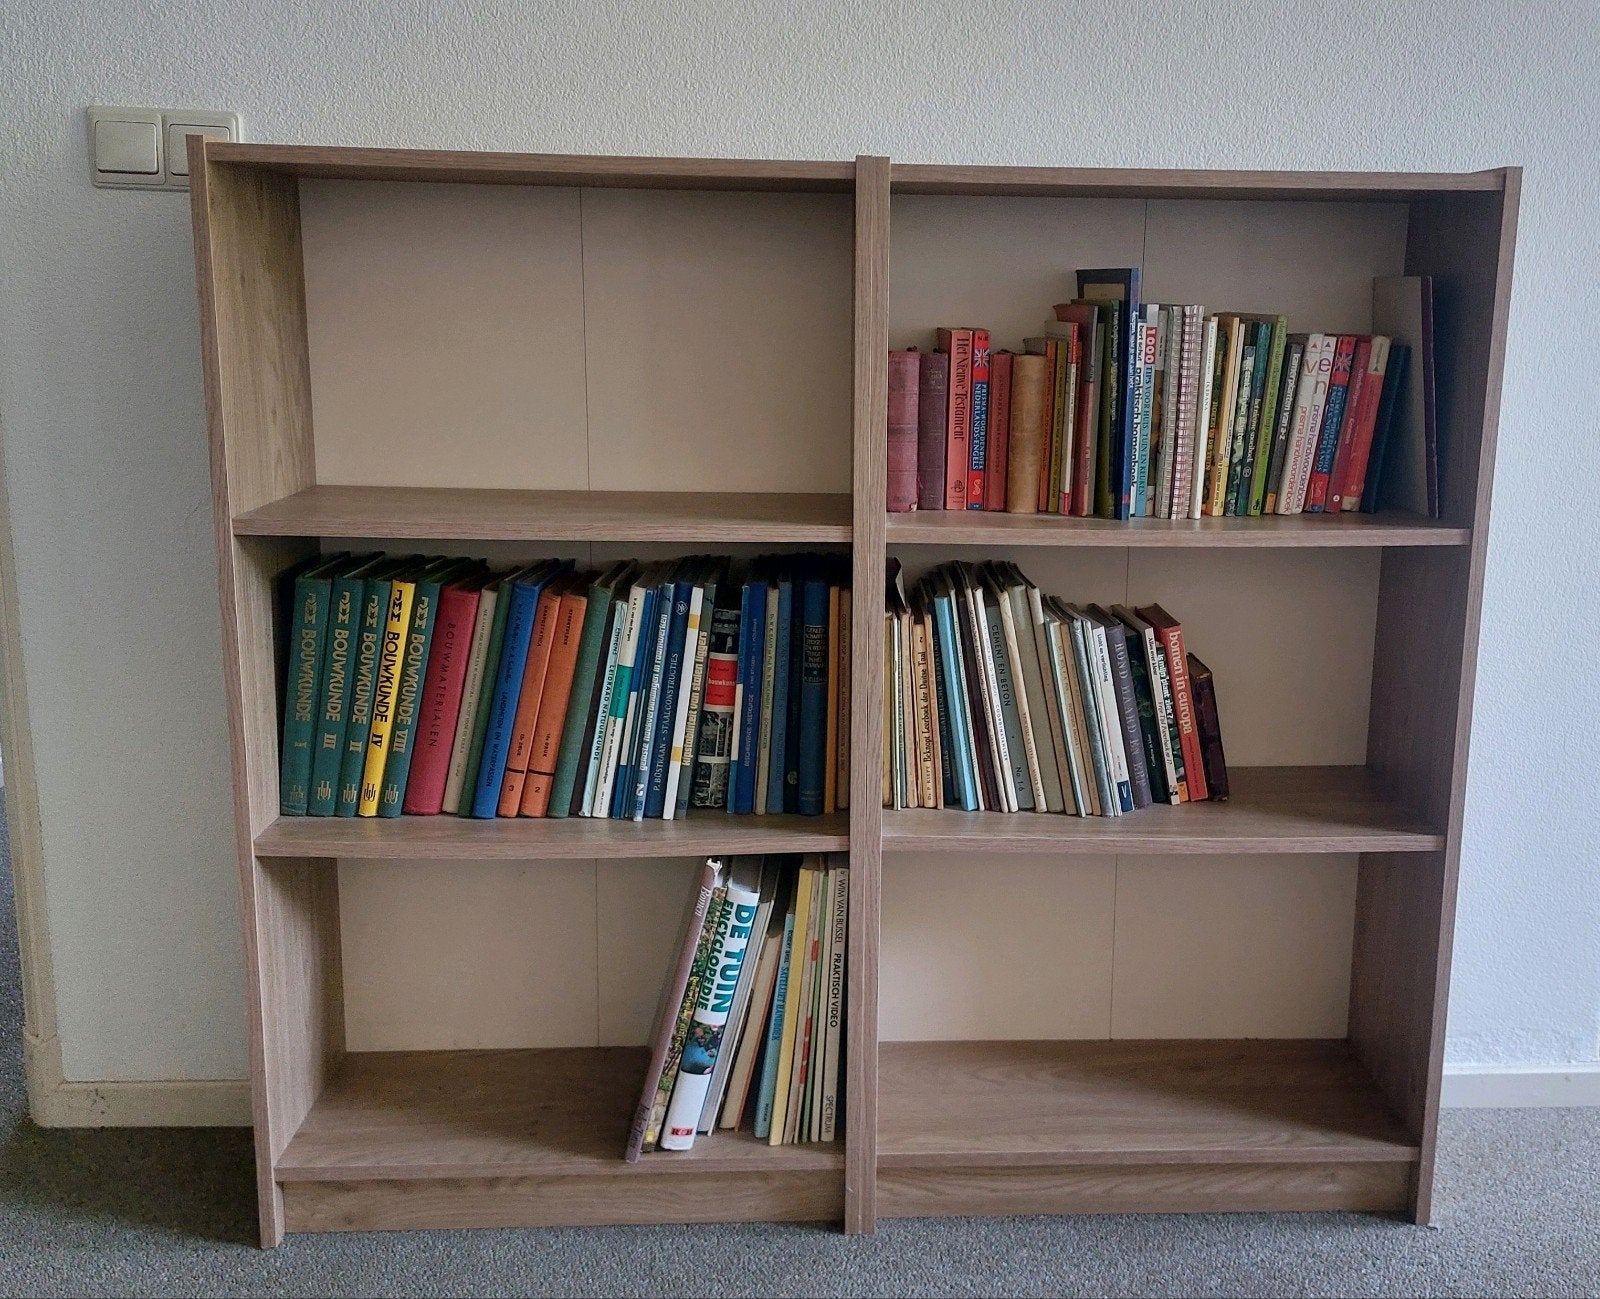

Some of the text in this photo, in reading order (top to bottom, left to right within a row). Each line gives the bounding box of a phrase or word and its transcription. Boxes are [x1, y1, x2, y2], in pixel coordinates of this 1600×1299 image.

[956, 337, 969, 355] Het
[1136, 340, 1144, 361] schut
[1144, 327, 1156, 364] 1000
[1143, 385, 1151, 409] VOOR
[1144, 365, 1153, 385] TIPS
[1282, 352, 1301, 411] kamerplanten
[953, 390, 967, 442] Testament
[970, 383, 982, 470] NEDERLANDS-ENGELS
[1280, 410, 1290, 427] van
[1139, 453, 1147, 464] EN
[1140, 433, 1149, 452] TUIN
[1281, 406, 1308, 513] prisma handwoordenboek
[1292, 403, 1321, 510] prisma handwoordenboek
[293, 628, 317, 721] BOUWKUNDE
[916, 650, 926, 666] Taal
[990, 624, 1011, 707] CEMENT EN BETON
[1157, 659, 1167, 678] mijn
[1168, 630, 1187, 675] bomen
[322, 628, 349, 749] BOUWKUNDE III
[348, 631, 378, 753] BOUWKUNDE II
[370, 630, 400, 748] BOUWKUNDE IV
[395, 633, 426, 725] BOUWKUNDE
[424, 621, 459, 747] BOUWMATERIALEN
[660, 650, 679, 734] STAALCONSTRUCTIES
[919, 690, 928, 703] der
[1160, 677, 1170, 697] plant
[1174, 674, 1189, 691] in
[592, 663, 615, 762] LEIDRAAD NATUURKUNDE
[1175, 690, 1194, 735] europa
[921, 734, 933, 762] Beknopt
[507, 783, 515, 793] 3
[533, 785, 541, 794] 2
[692, 885, 712, 918] Bomen
[833, 878, 847, 944] WIM VAN BUSSEL
[695, 899, 734, 1011] ENCYCLOPEDIE
[710, 903, 758, 1013] DE TUIN
[828, 953, 842, 1028] PRAKTISCH VIDEO
[822, 1094, 834, 1133] SPECTRUM
